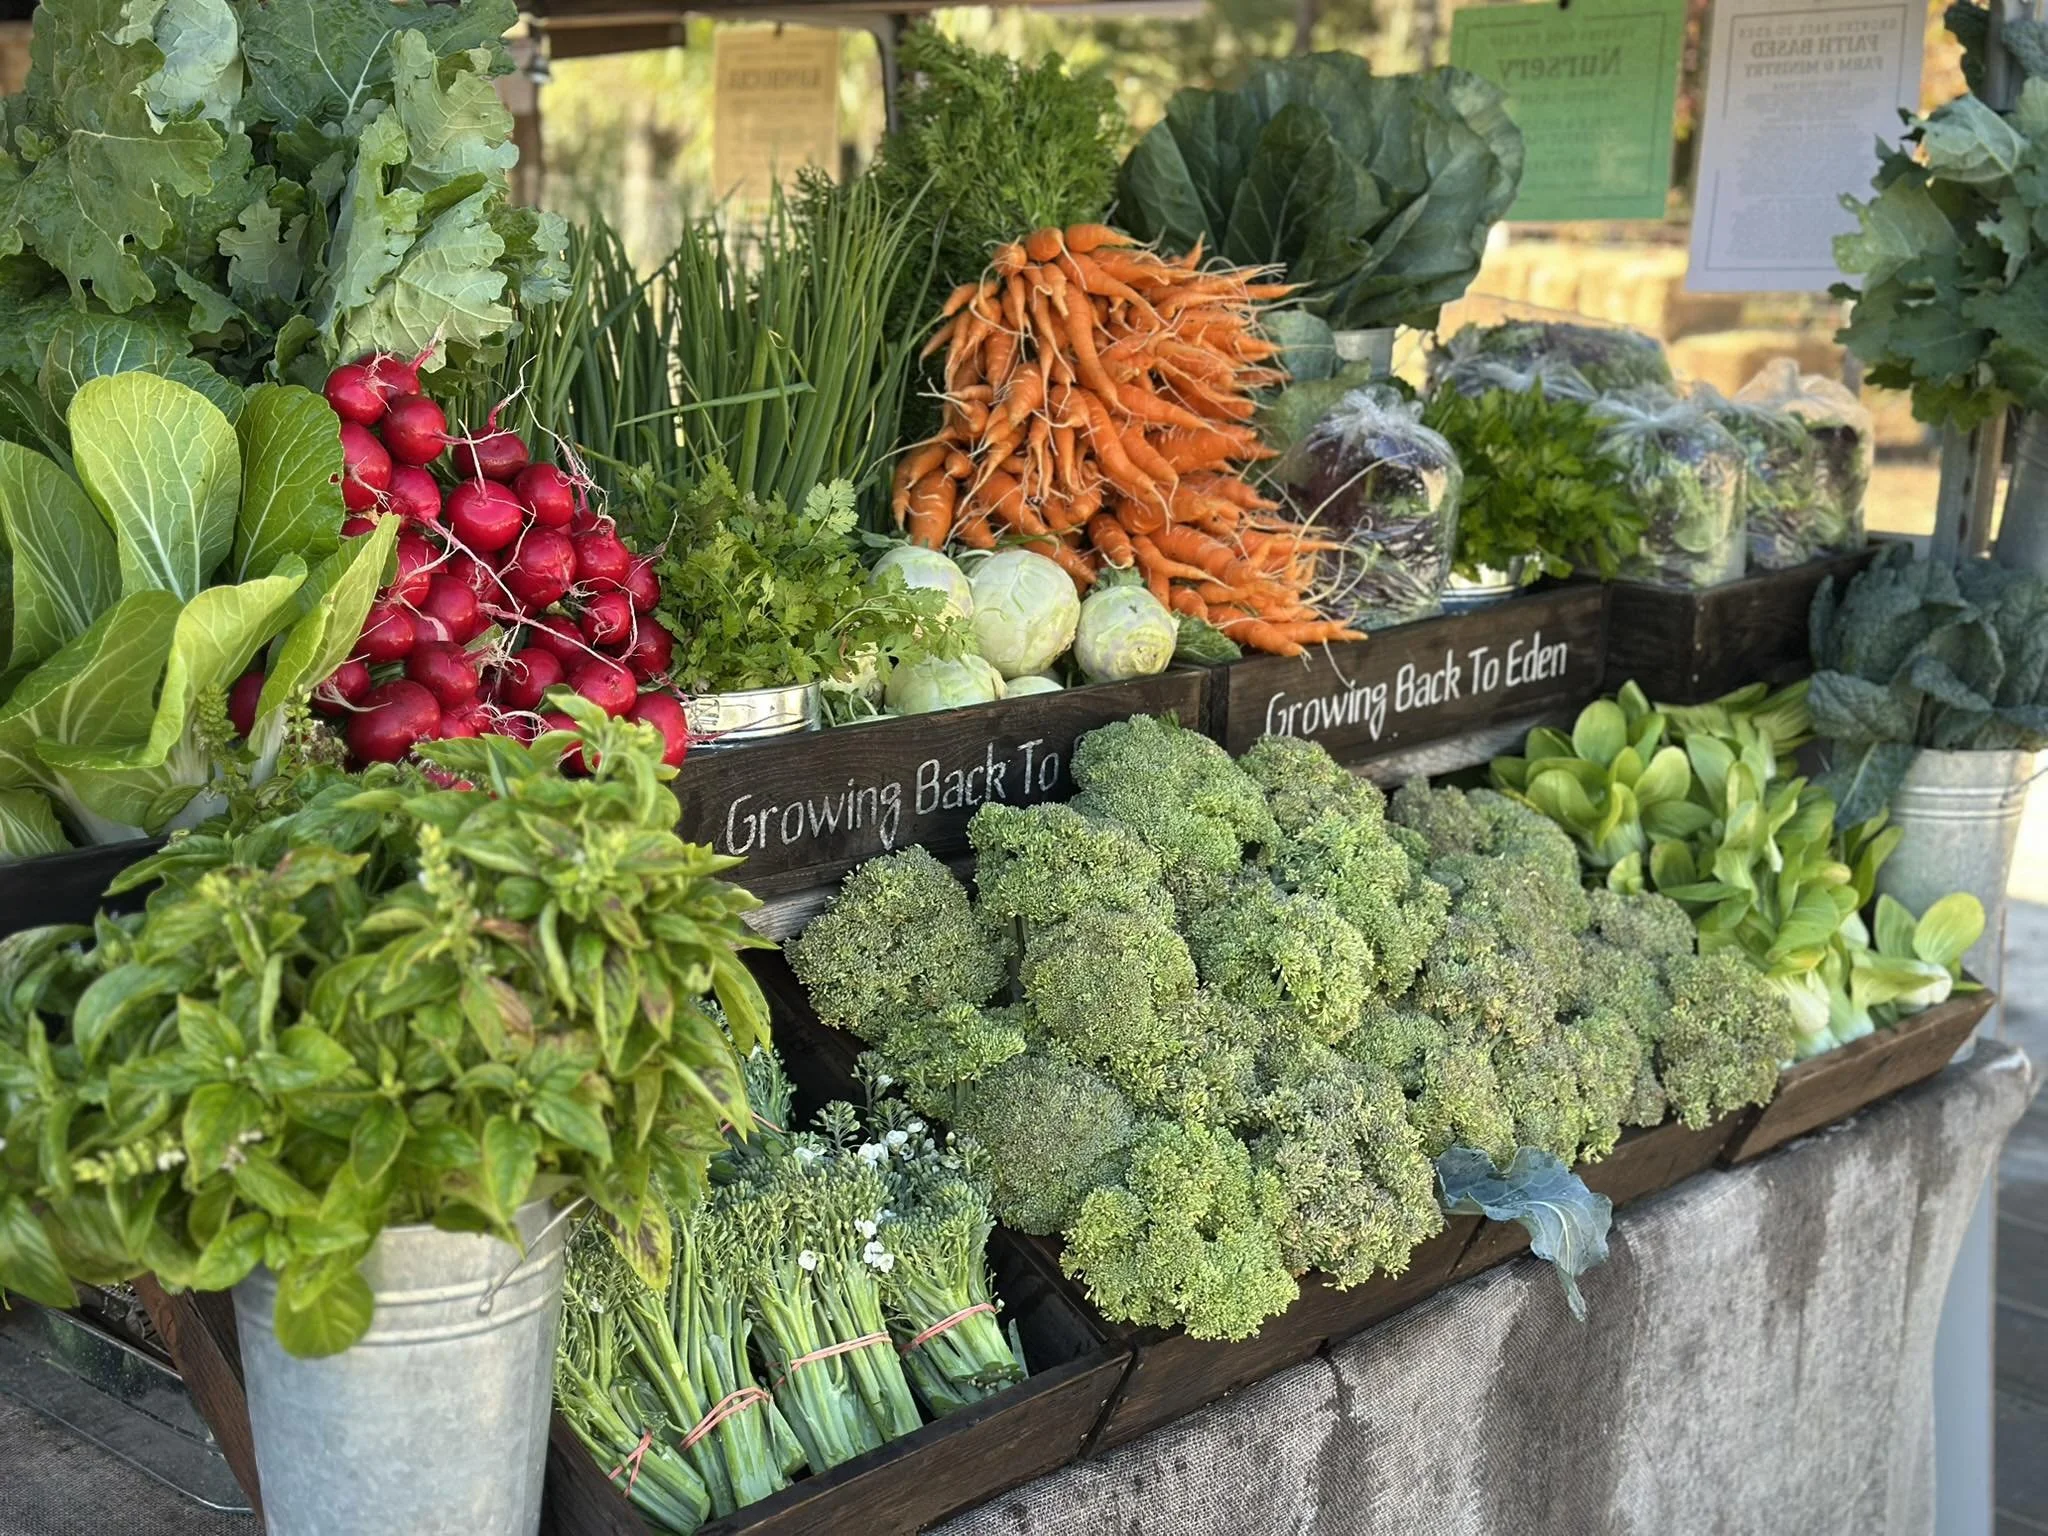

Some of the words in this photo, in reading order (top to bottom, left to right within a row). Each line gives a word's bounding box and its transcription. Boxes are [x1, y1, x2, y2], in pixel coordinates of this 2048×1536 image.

[1265, 679, 1388, 742] Growing
[1394, 649, 1460, 713] Back
[1467, 646, 1499, 695] To
[1505, 631, 1568, 687] Eden
[725, 778, 902, 856] Growing
[915, 742, 1007, 815] Back
[1016, 738, 1059, 795] To
